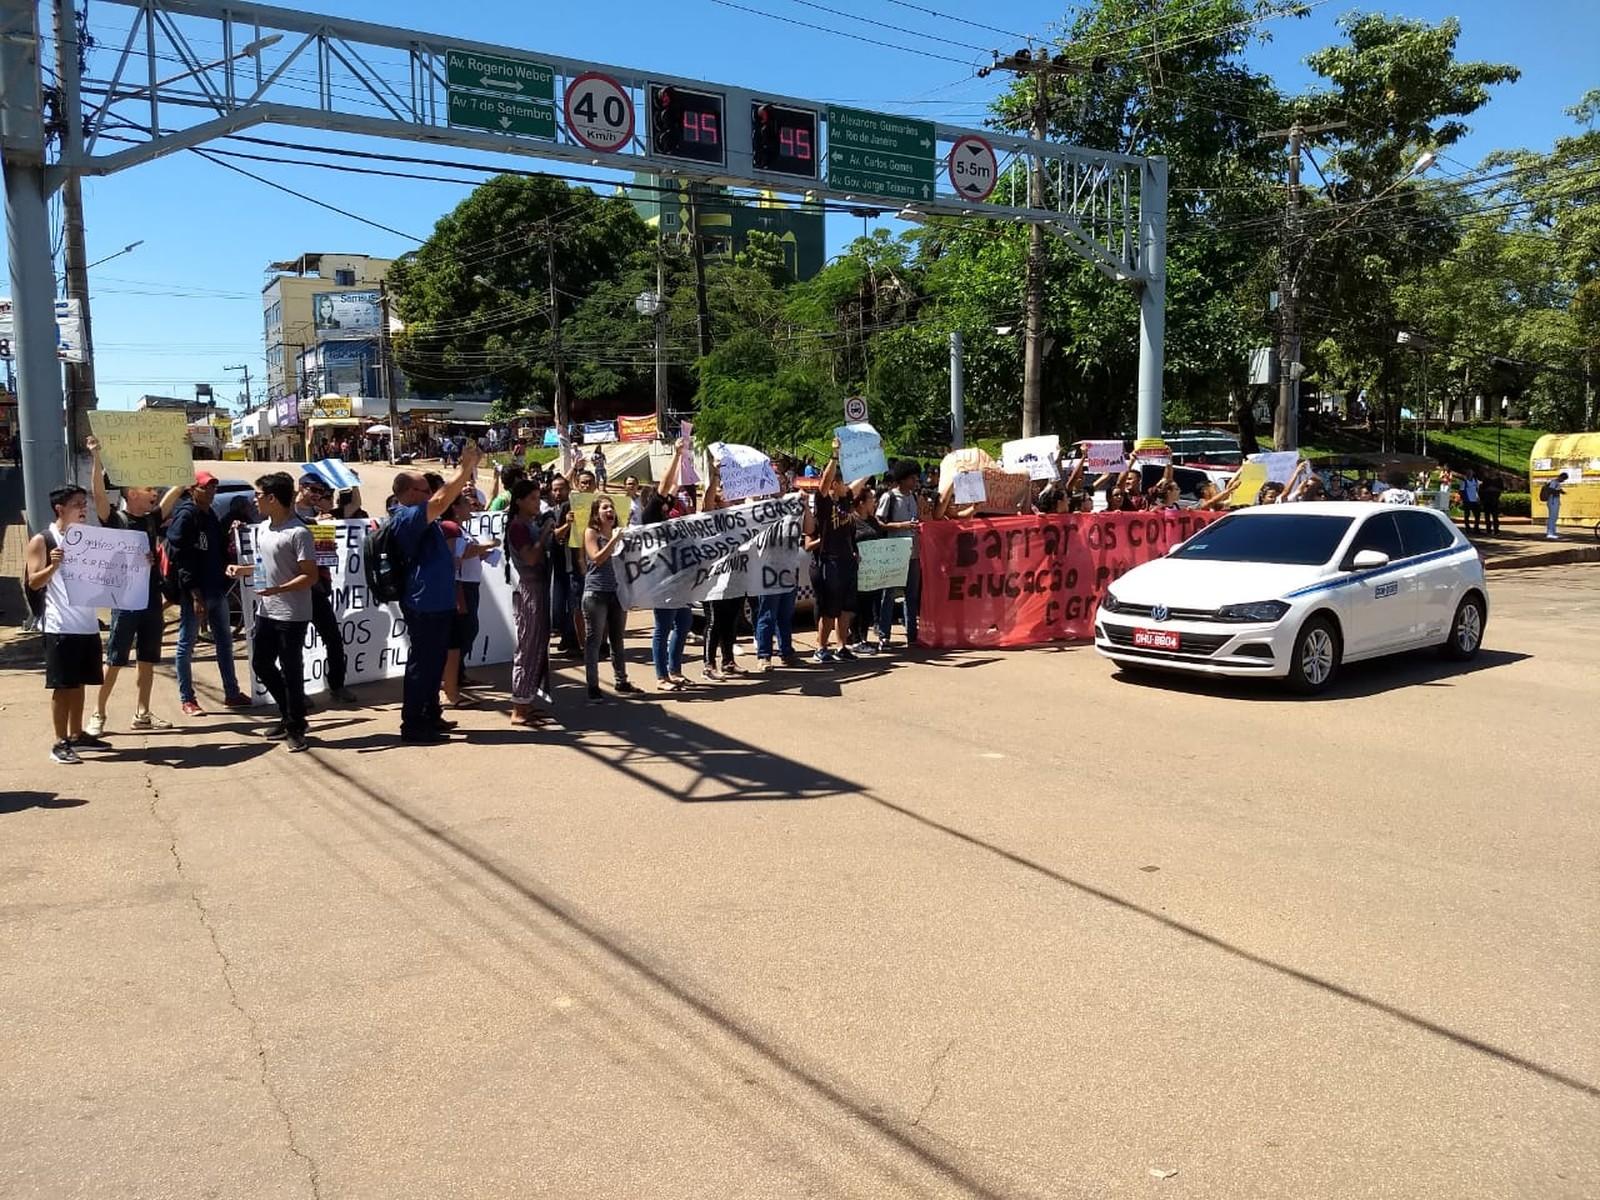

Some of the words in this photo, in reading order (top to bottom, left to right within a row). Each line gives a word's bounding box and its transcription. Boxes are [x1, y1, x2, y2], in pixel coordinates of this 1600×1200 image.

[449, 55, 465, 69] Av.
[468, 57, 513, 76] Rogerio
[515, 65, 552, 83] Weber
[480, 100, 495, 112] de
[497, 102, 552, 121] Setembro
[573, 92, 625, 127] 40
[840, 113, 877, 130] Alexandre
[586, 129, 616, 142] Km/h
[683, 110, 717, 143] 45
[846, 129, 859, 142] Rio
[860, 132, 869, 144] de
[870, 134, 898, 148] Janeiro
[780, 127, 811, 160] 45
[864, 155, 888, 169] Carlos
[889, 159, 913, 173] Gomes
[862, 178, 885, 193] Jorge
[885, 180, 915, 195] Teixeira
[657, 536, 741, 576] VERBAS
[955, 524, 1078, 568] Barrar
